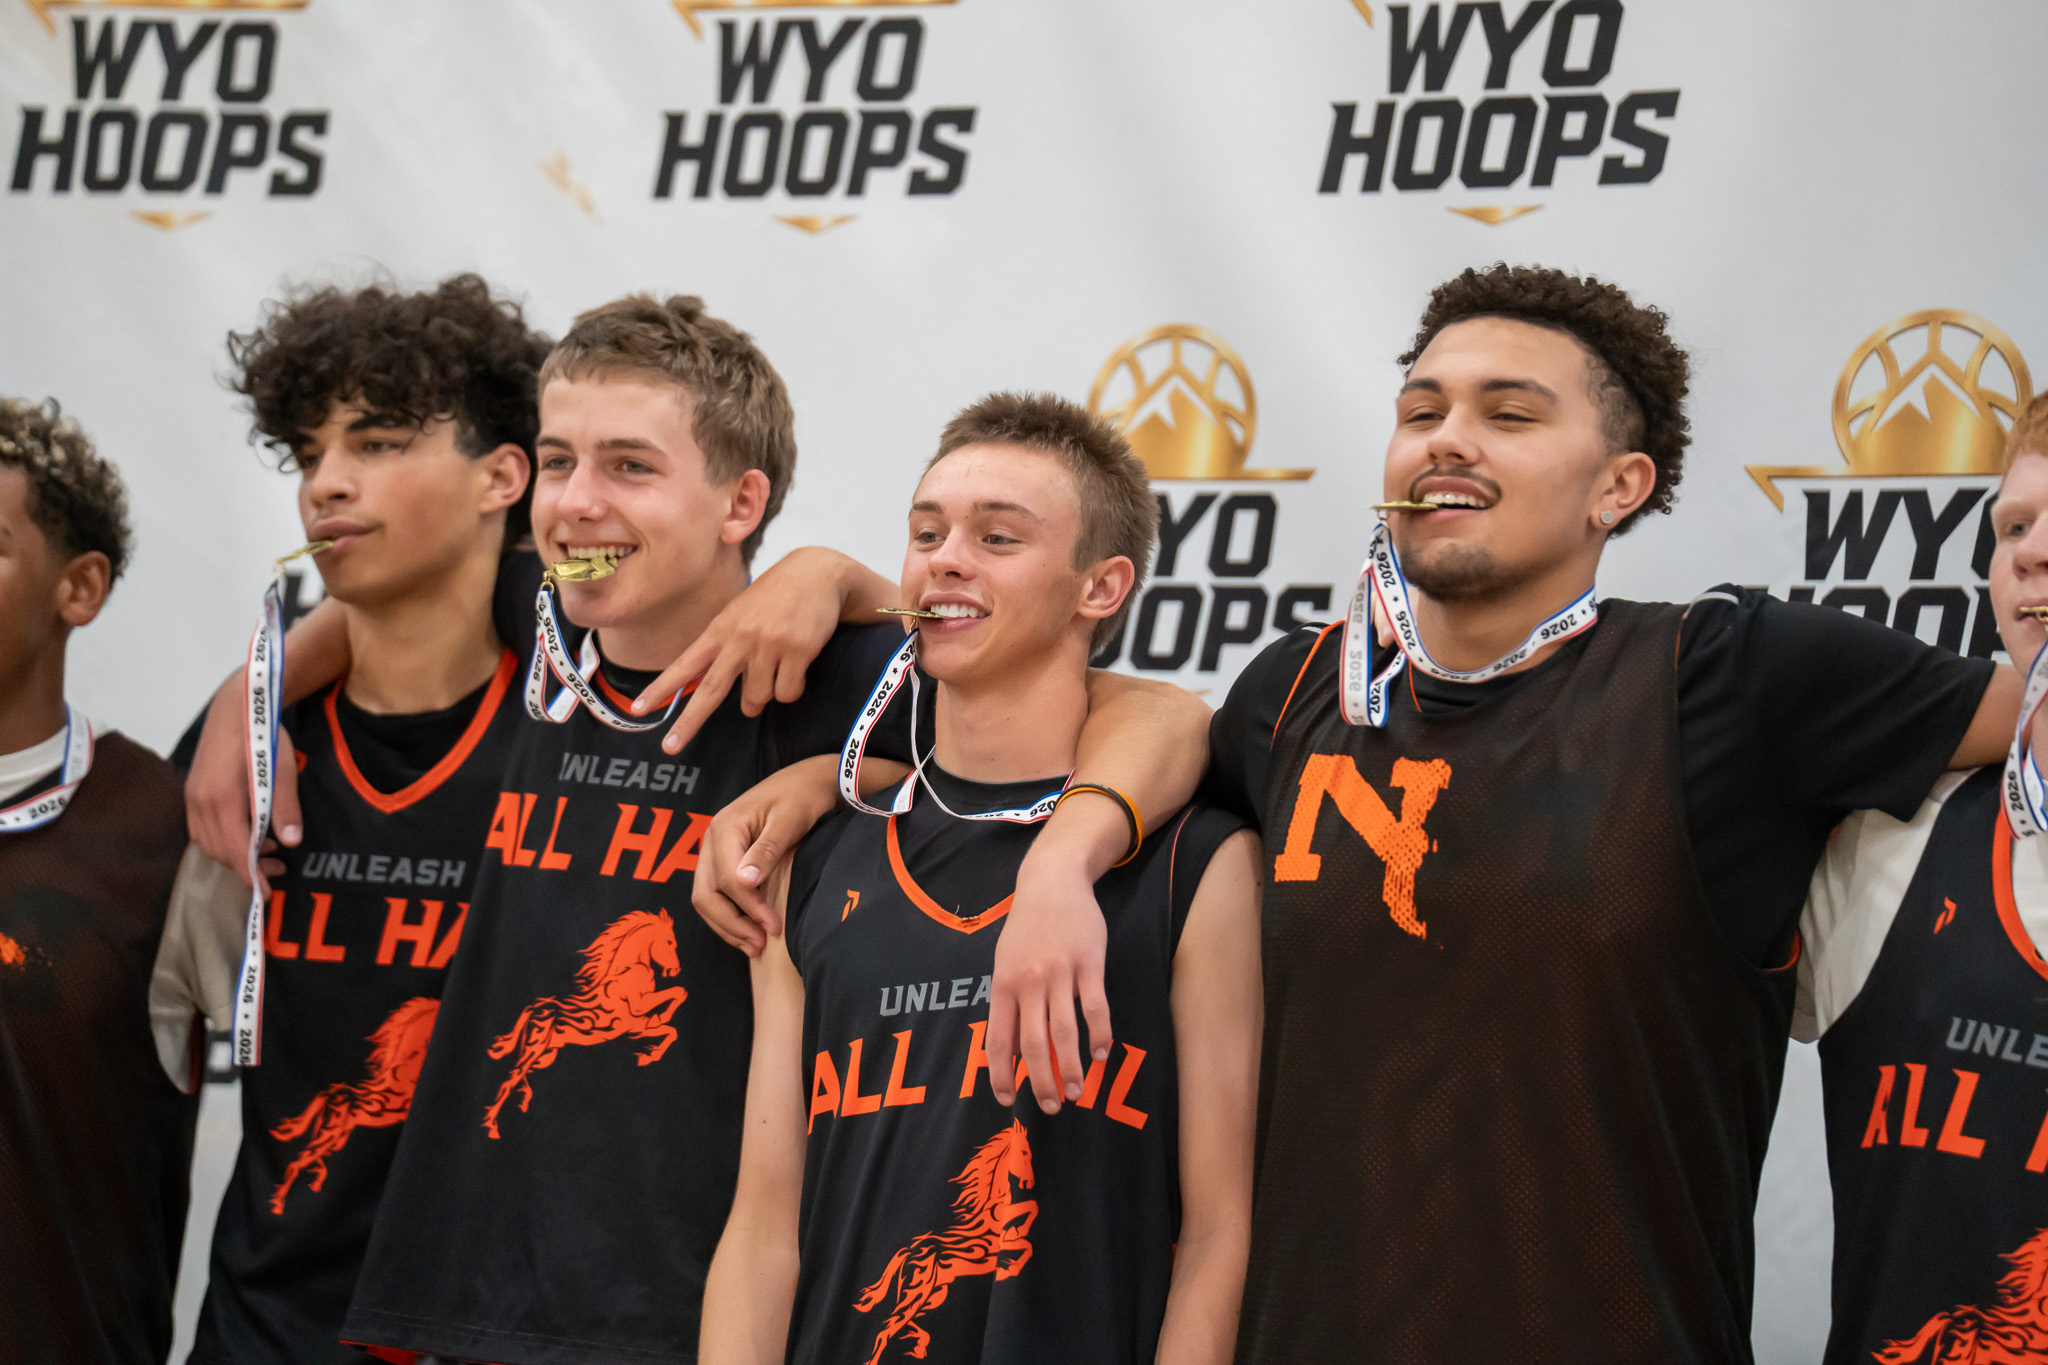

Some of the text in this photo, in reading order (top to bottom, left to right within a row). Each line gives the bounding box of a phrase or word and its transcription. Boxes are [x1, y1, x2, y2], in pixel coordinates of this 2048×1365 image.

[72, 17, 279, 101] WYO
[717, 18, 924, 104] WYO
[1388, 0, 1624, 94] WYO
[11, 108, 329, 195] HOOPS
[652, 107, 977, 198] HOOPS
[1318, 90, 1681, 193] HOOPS
[1155, 493, 1277, 577] YO
[1377, 552, 1396, 588] 2026
[1396, 611, 1416, 650] 2026
[1541, 614, 1577, 639] 2026
[543, 617, 559, 654] 2026
[567, 673, 596, 705] 2026
[867, 681, 893, 717] 2026
[254, 687, 265, 725] 2026
[257, 750, 268, 788] 2026
[844, 738, 860, 779] 2026
[2008, 771, 2025, 811] 2026
[485, 792, 572, 870] ALL
[1030, 800, 1056, 817] 026
[303, 852, 466, 888] UNLEASH
[264, 889, 347, 962] LL
[244, 966, 257, 1003] 2026
[808, 1029, 926, 1135] ALL
[1861, 1062, 1986, 1158] ALL
